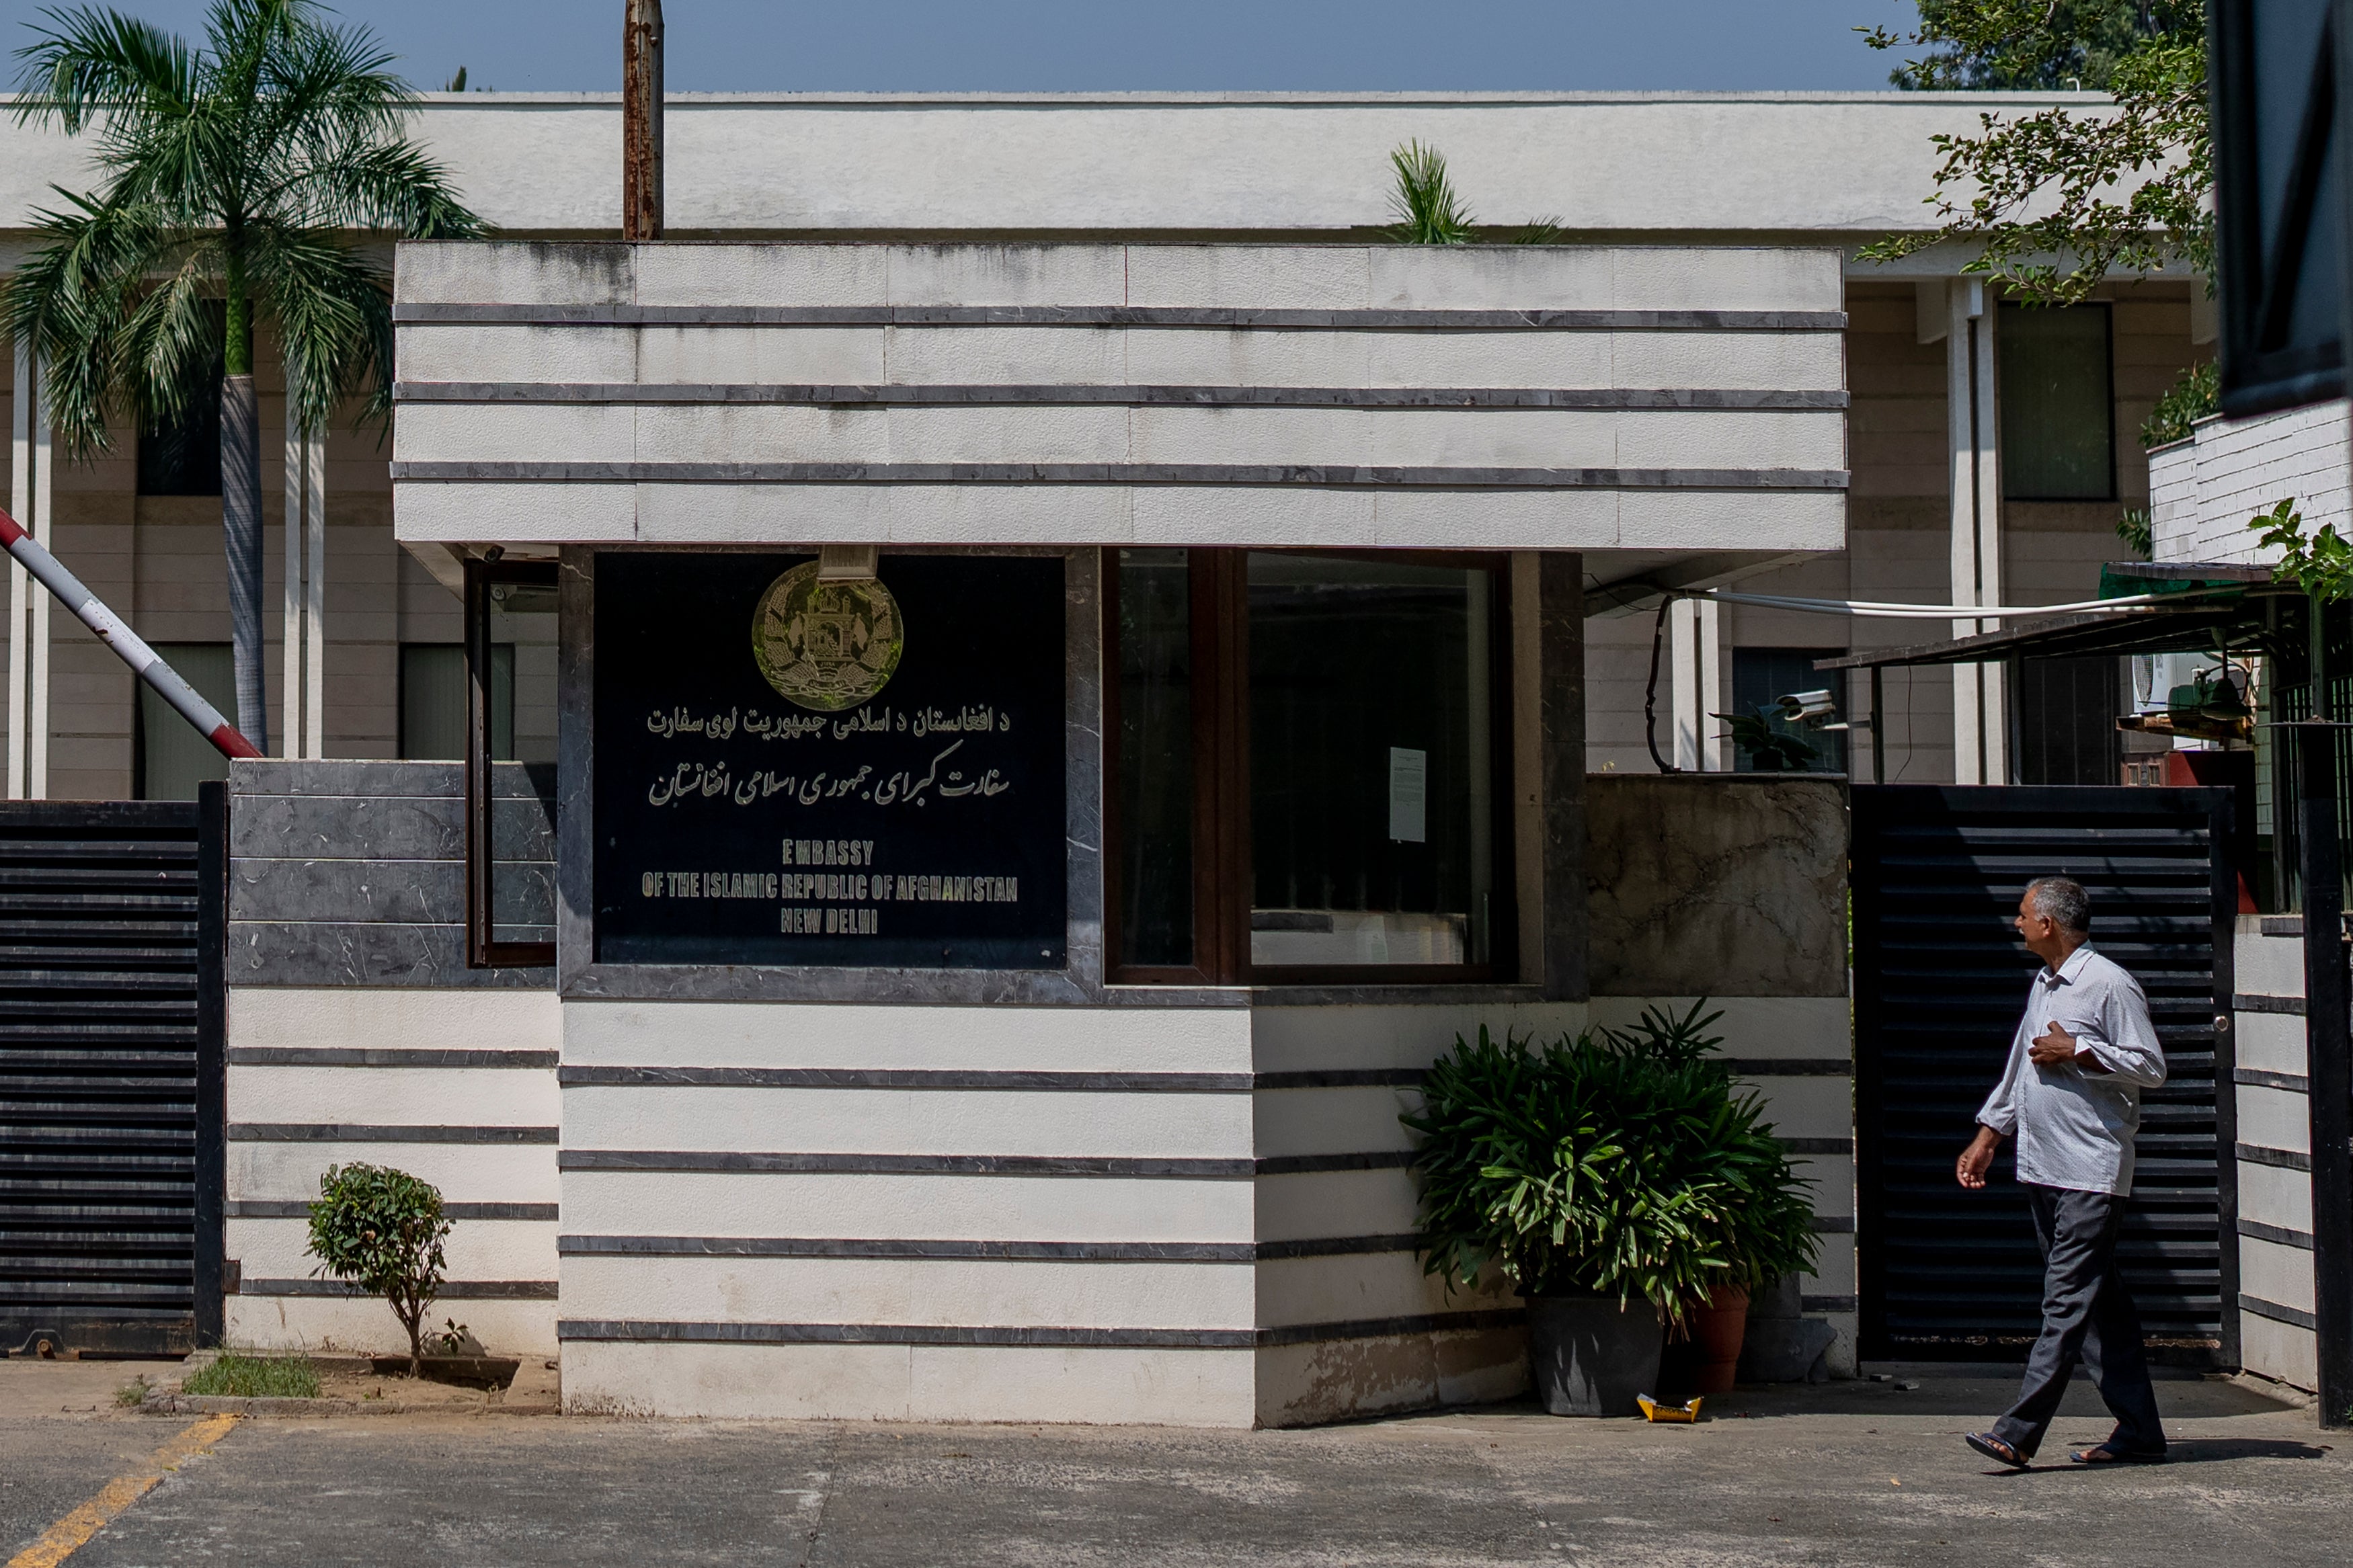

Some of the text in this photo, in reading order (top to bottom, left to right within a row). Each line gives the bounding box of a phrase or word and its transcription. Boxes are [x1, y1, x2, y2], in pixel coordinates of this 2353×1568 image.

[782, 839, 874, 866] EMBASSY
[642, 872, 1018, 902] OF THE ISLAMIC REPUBLIC OF AFGHANISTAN
[781, 908, 878, 934] NEW DELHI
